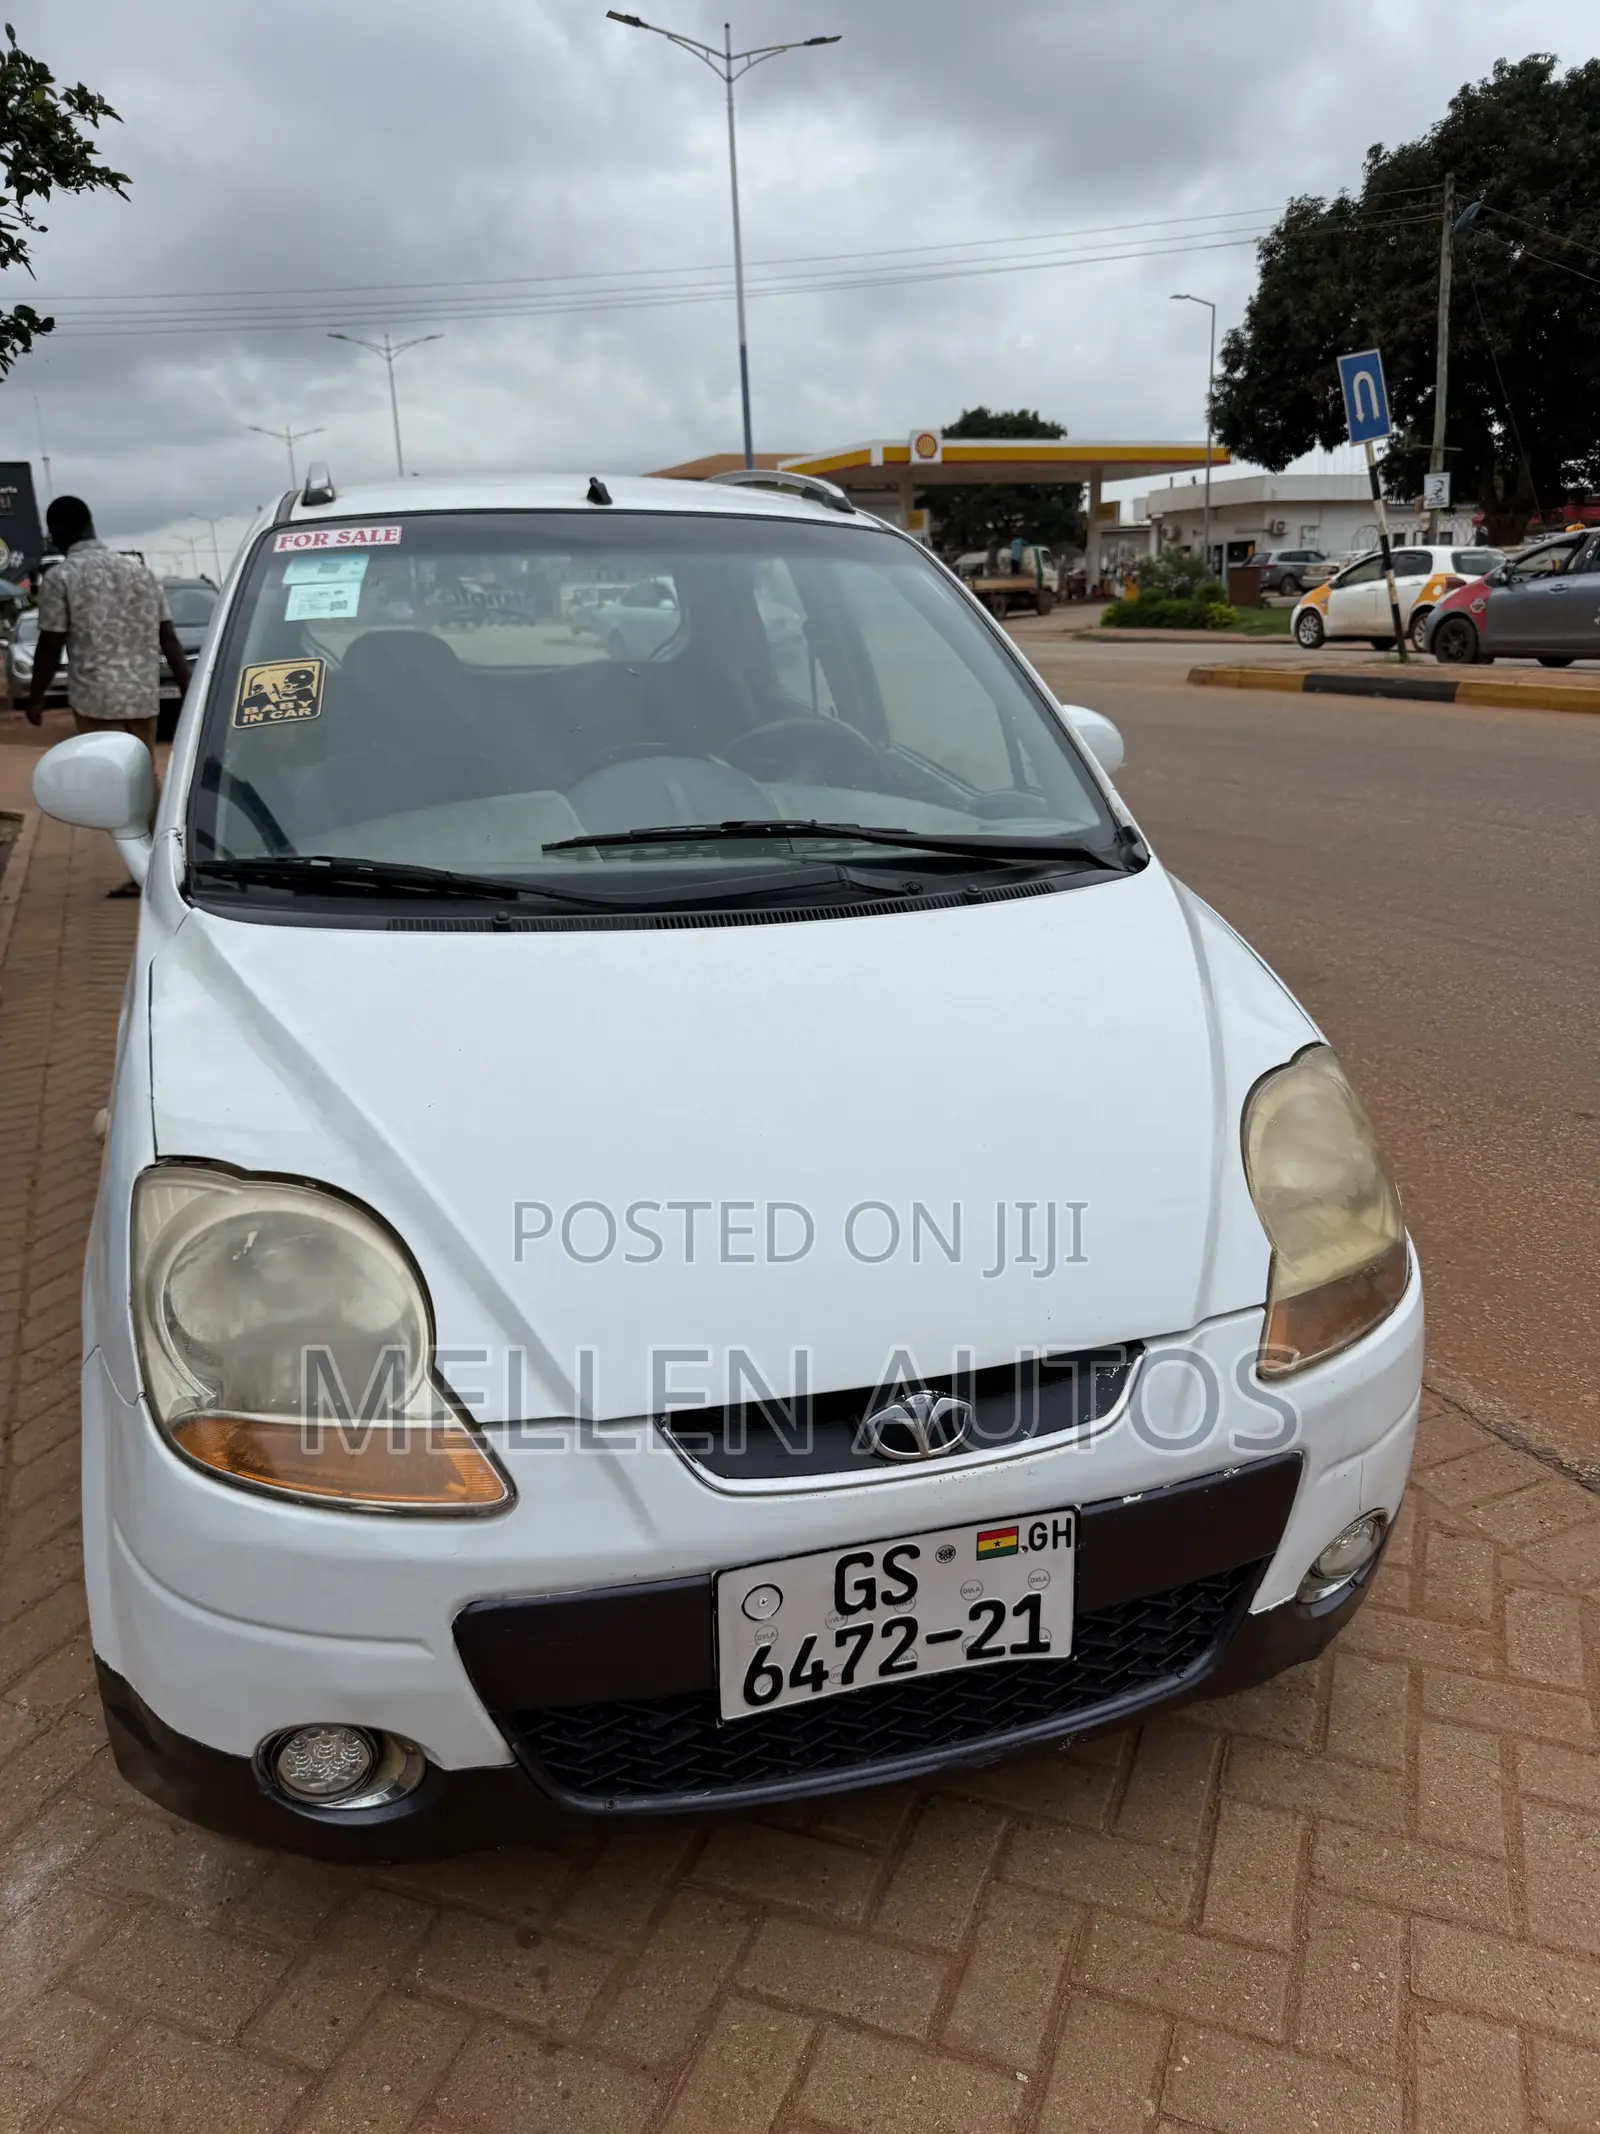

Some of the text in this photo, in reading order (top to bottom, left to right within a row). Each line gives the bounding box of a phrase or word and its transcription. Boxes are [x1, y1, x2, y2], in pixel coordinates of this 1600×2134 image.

[278, 529, 398, 549] FOR SALE
[244, 700, 314, 714] BABY
[243, 708, 312, 723] IN CAR
[834, 1543, 921, 1616] GS
[1030, 1575, 1048, 1583] DVLA
[962, 1586, 981, 1594] DVLA
[757, 1631, 775, 1640] DVLA
[743, 1592, 1051, 1707] 6472-21
